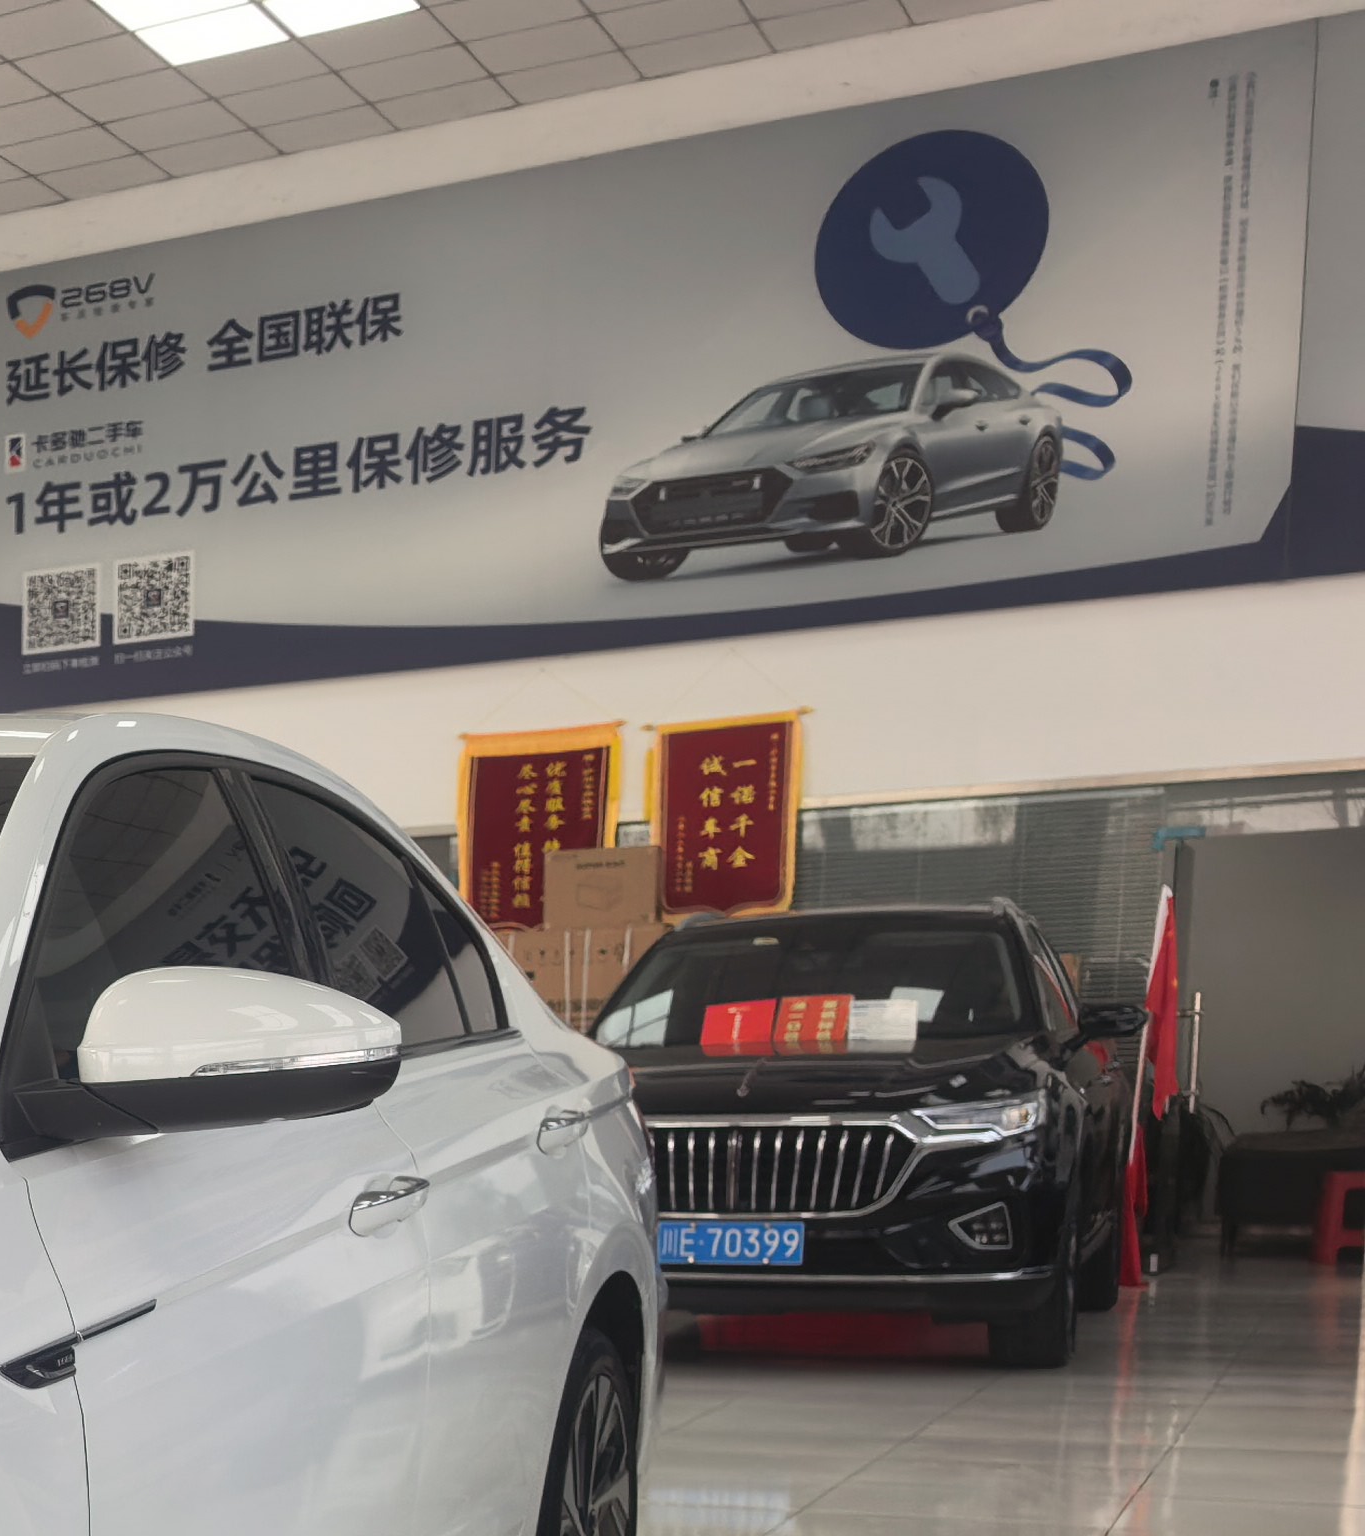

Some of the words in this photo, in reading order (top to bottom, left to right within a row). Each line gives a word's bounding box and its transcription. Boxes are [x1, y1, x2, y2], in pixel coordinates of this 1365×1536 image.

[60, 272, 155, 308] 268V
[5, 331, 186, 406] 延长保修
[206, 293, 403, 373] 全国联保
[5, 405, 592, 535] 1年或2万公里保修服务
